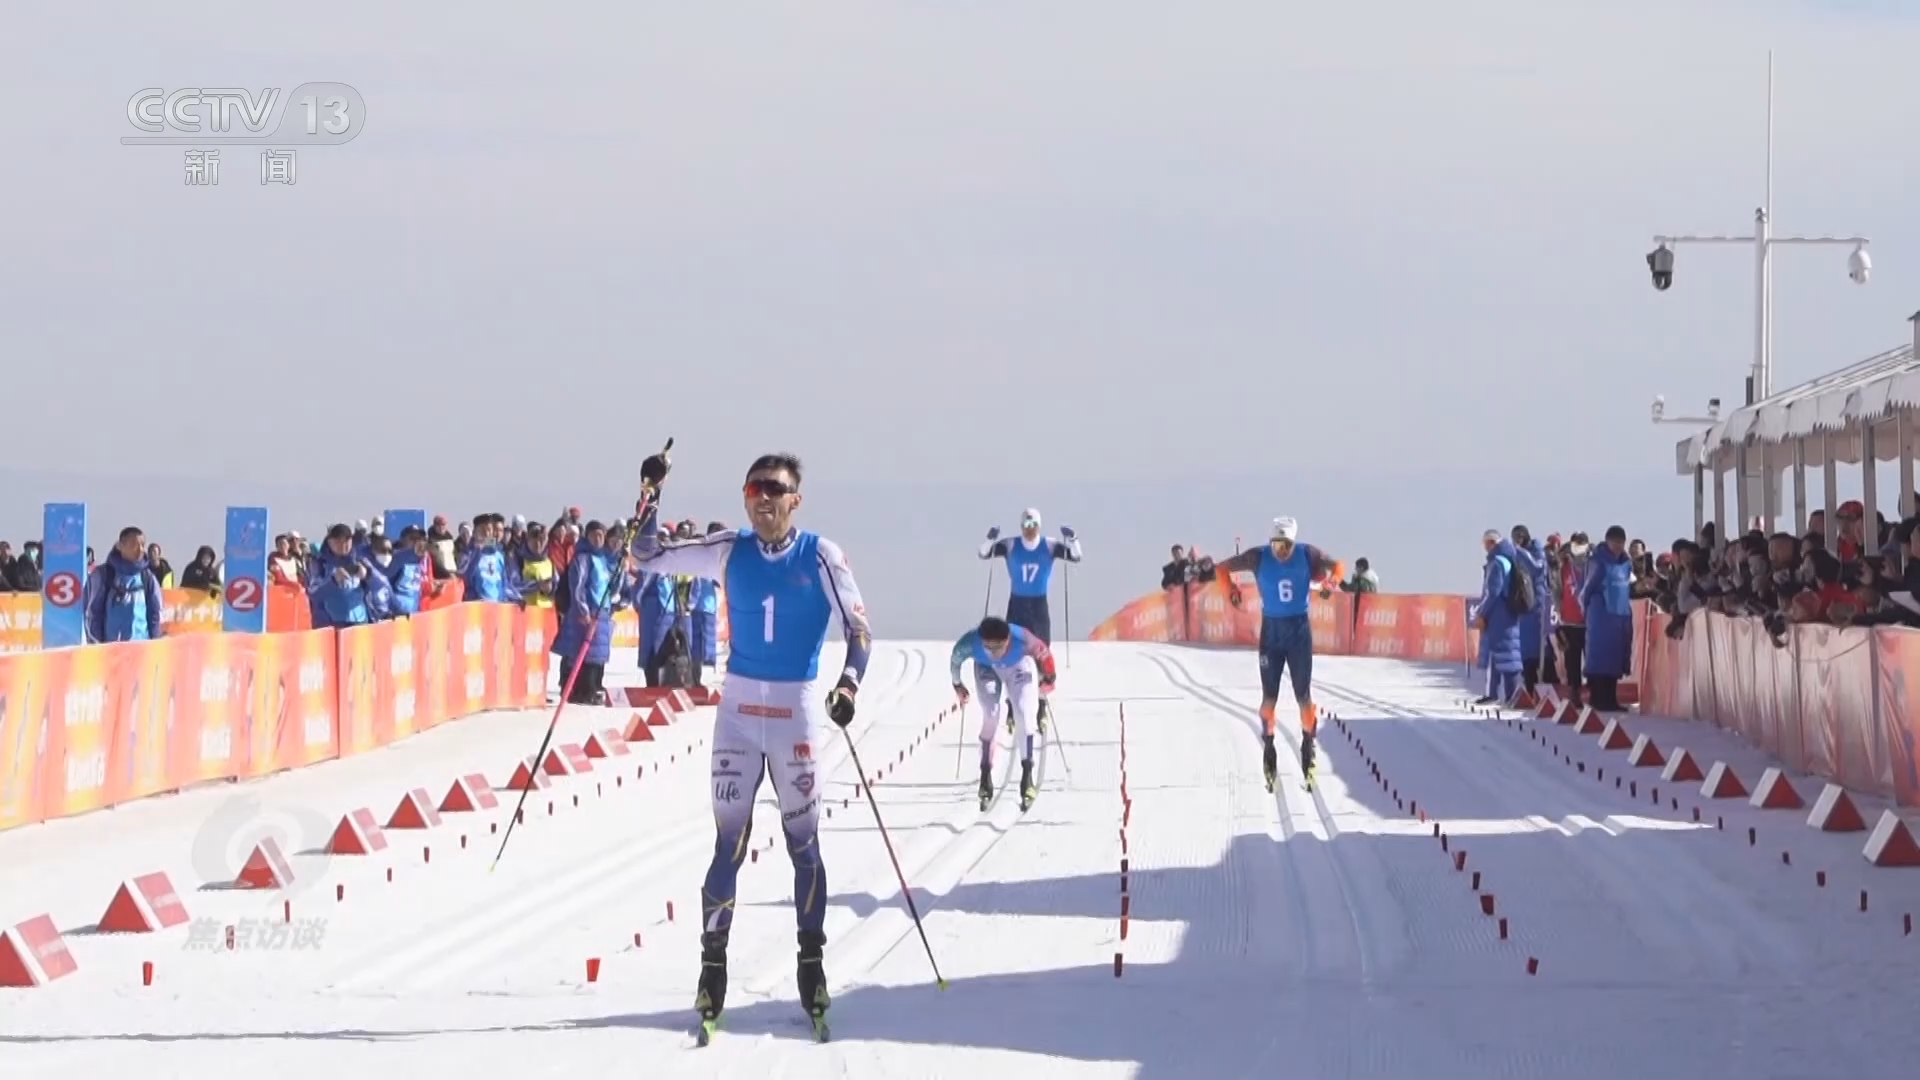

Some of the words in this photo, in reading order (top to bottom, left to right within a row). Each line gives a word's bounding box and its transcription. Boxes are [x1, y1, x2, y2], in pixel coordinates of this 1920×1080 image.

[1021, 563, 1039, 583] 17
[52, 574, 74, 604] 3
[232, 579, 255, 609] 2
[1278, 579, 1293, 602] 6
[761, 595, 774, 642] 1
[715, 781, 741, 804] life
